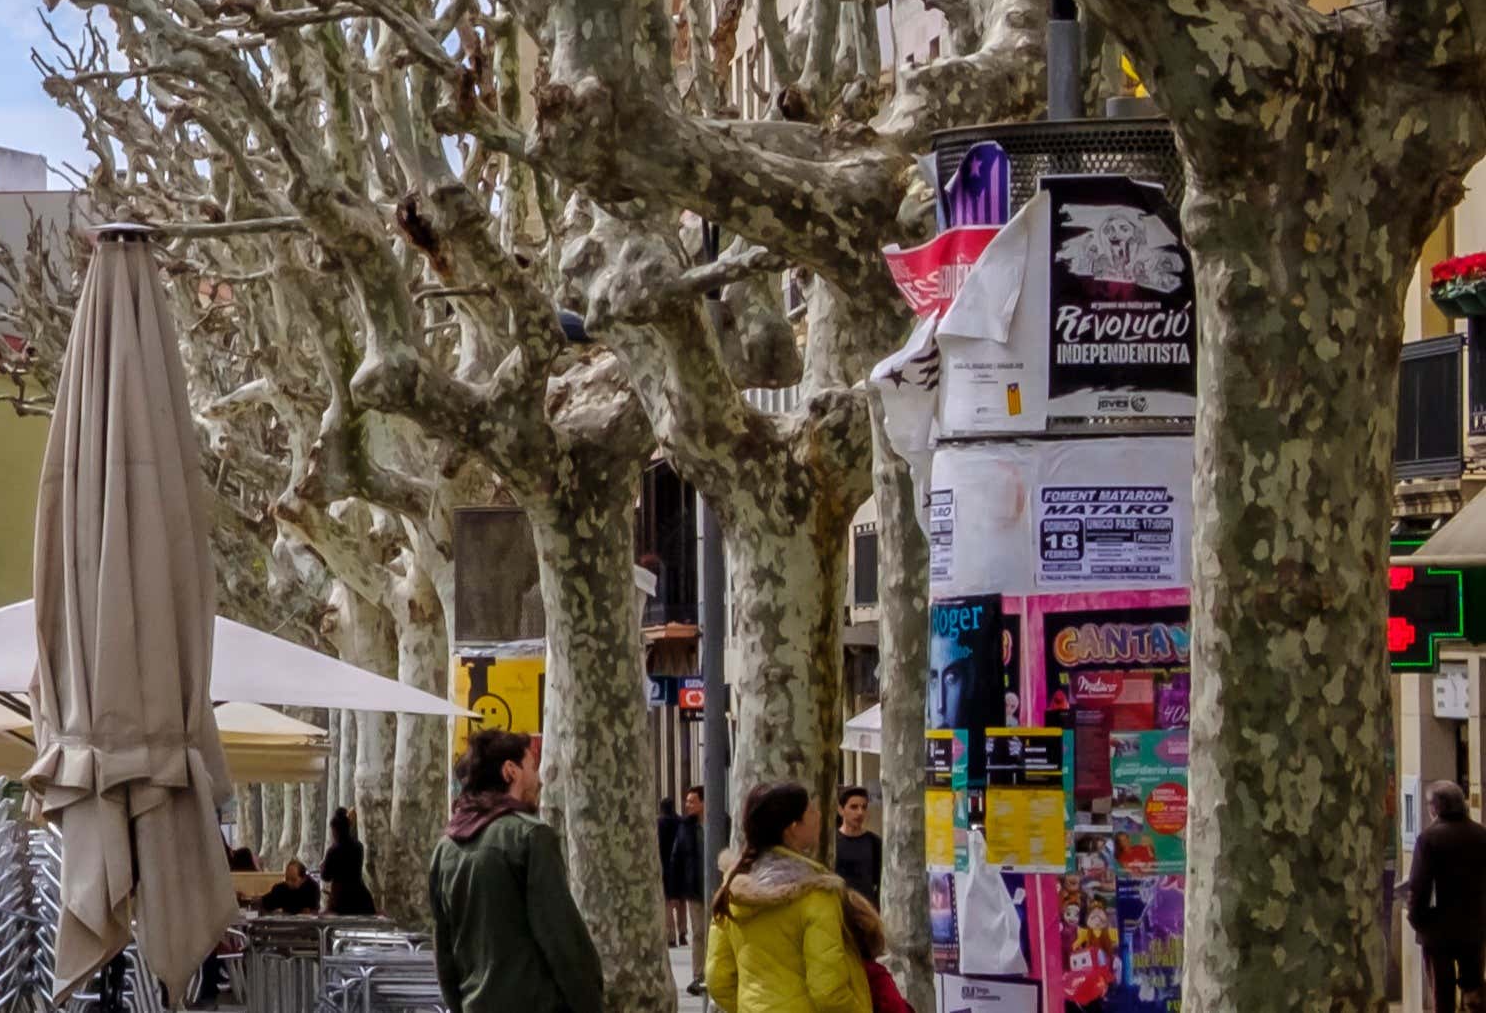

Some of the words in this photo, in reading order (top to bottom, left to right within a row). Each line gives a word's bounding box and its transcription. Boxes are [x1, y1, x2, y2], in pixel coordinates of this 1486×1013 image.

[1056, 343, 1190, 365] INDEPENDENTISTA
[1044, 490, 1097, 502] FOMENT
[1045, 504, 1170, 516] MATARO
[1045, 533, 1079, 549] 18
